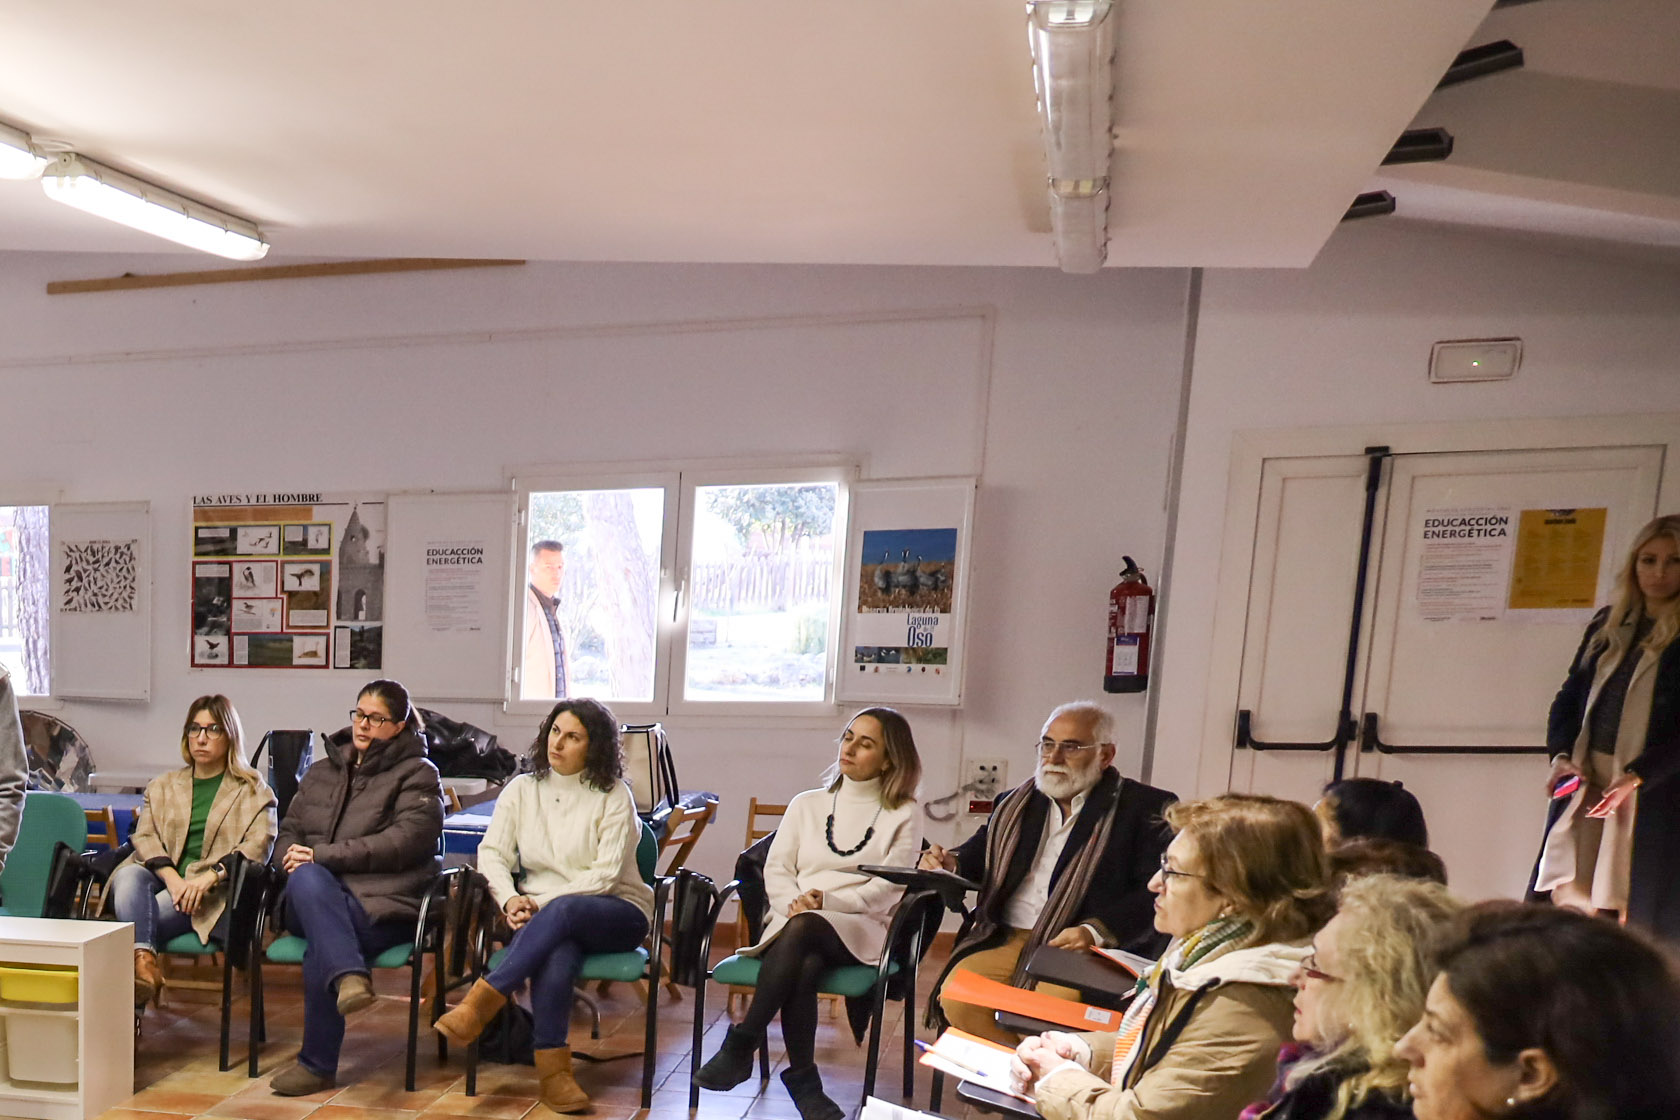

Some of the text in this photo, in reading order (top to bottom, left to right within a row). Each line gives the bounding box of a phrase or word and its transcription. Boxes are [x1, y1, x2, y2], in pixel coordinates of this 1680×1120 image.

[193, 493, 323, 504] LAS AVES Y EL HOMBRE
[1424, 515, 1508, 528] EDUCACCIÓN
[1423, 527, 1507, 539] ENERGÉTICA
[426, 547, 483, 556] EDUCACCIÓN
[426, 556, 483, 565] ENERGÉTICA
[907, 613, 939, 629] Laguna
[907, 625, 933, 648] Oso
